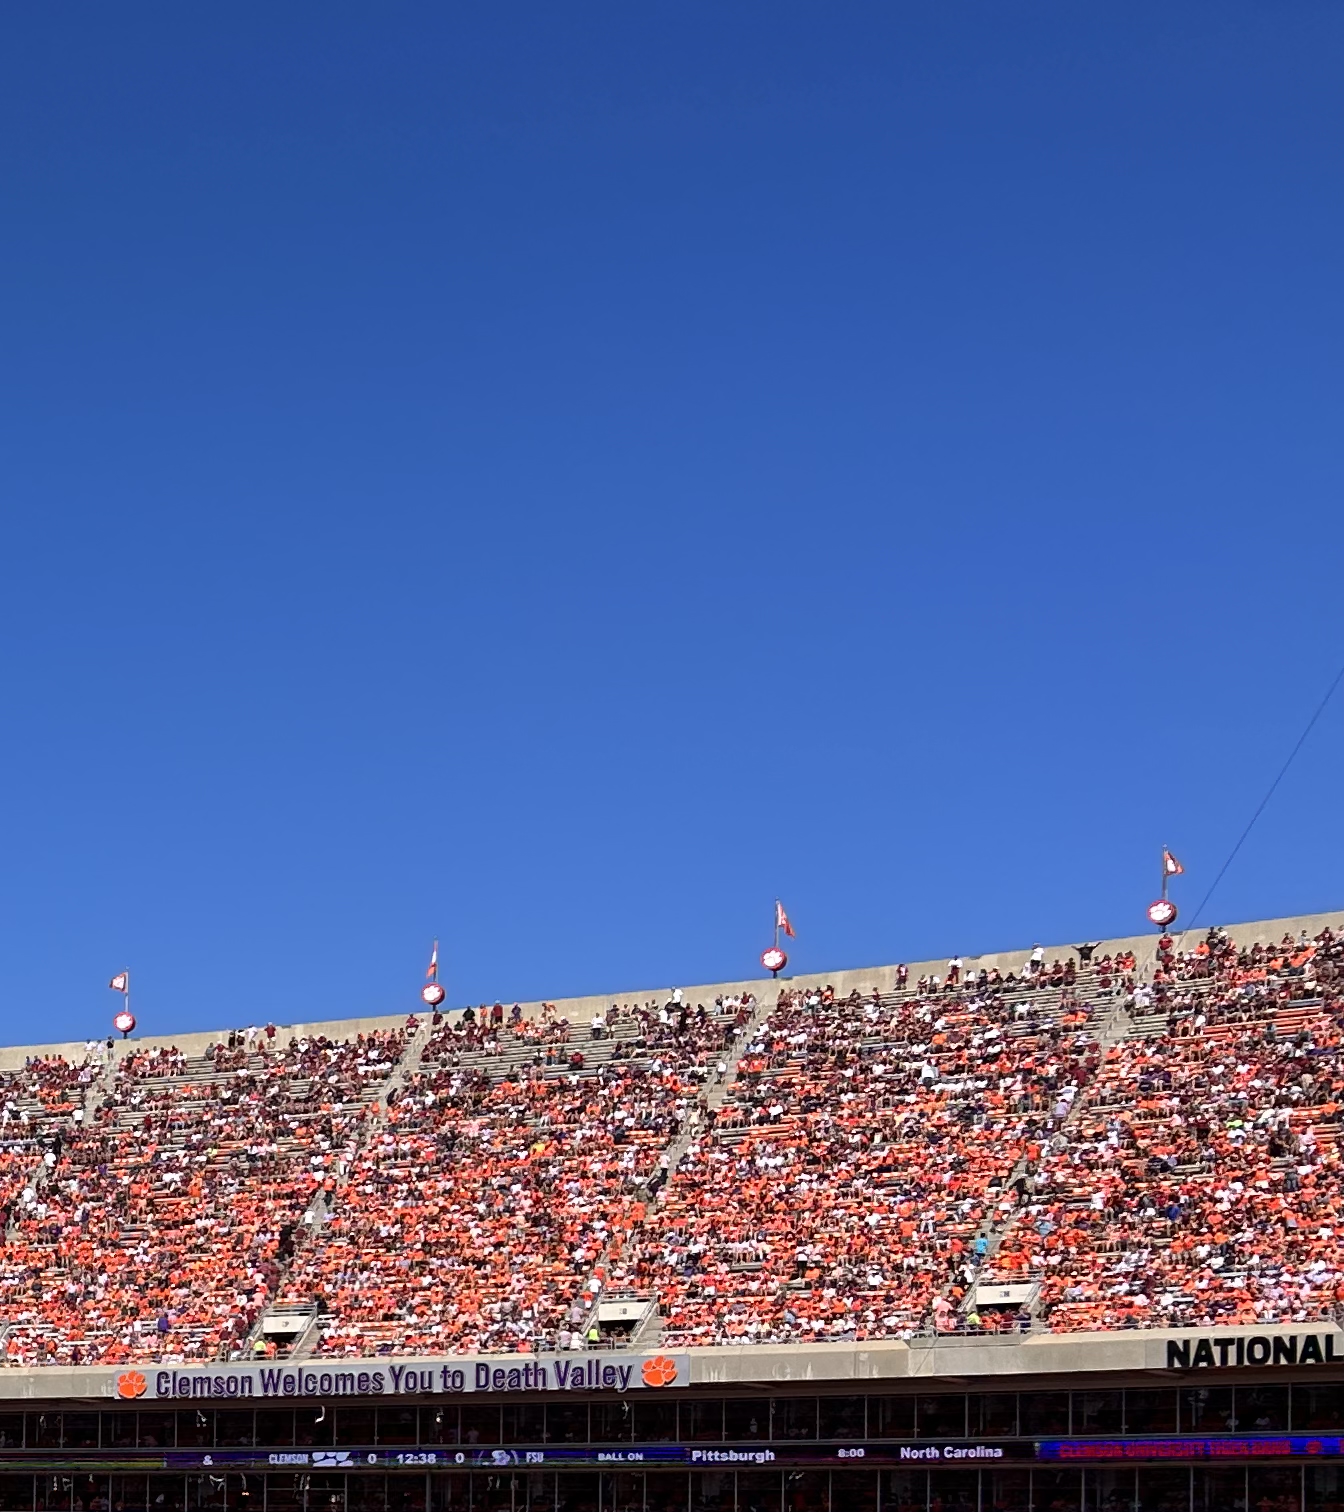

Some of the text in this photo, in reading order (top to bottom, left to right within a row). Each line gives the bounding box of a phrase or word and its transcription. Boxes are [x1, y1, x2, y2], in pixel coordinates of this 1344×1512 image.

[1166, 1334, 1344, 1369] NATIONAL
[156, 1357, 634, 1397] Clemson Welcomes You to Death Valley
[268, 1451, 644, 1464] CLEMSON 0 12:38 0 FSU BALL ON
[691, 1449, 776, 1464] Pittsburgh
[900, 1446, 940, 1459] North
[943, 1446, 1003, 1459] Carolina
